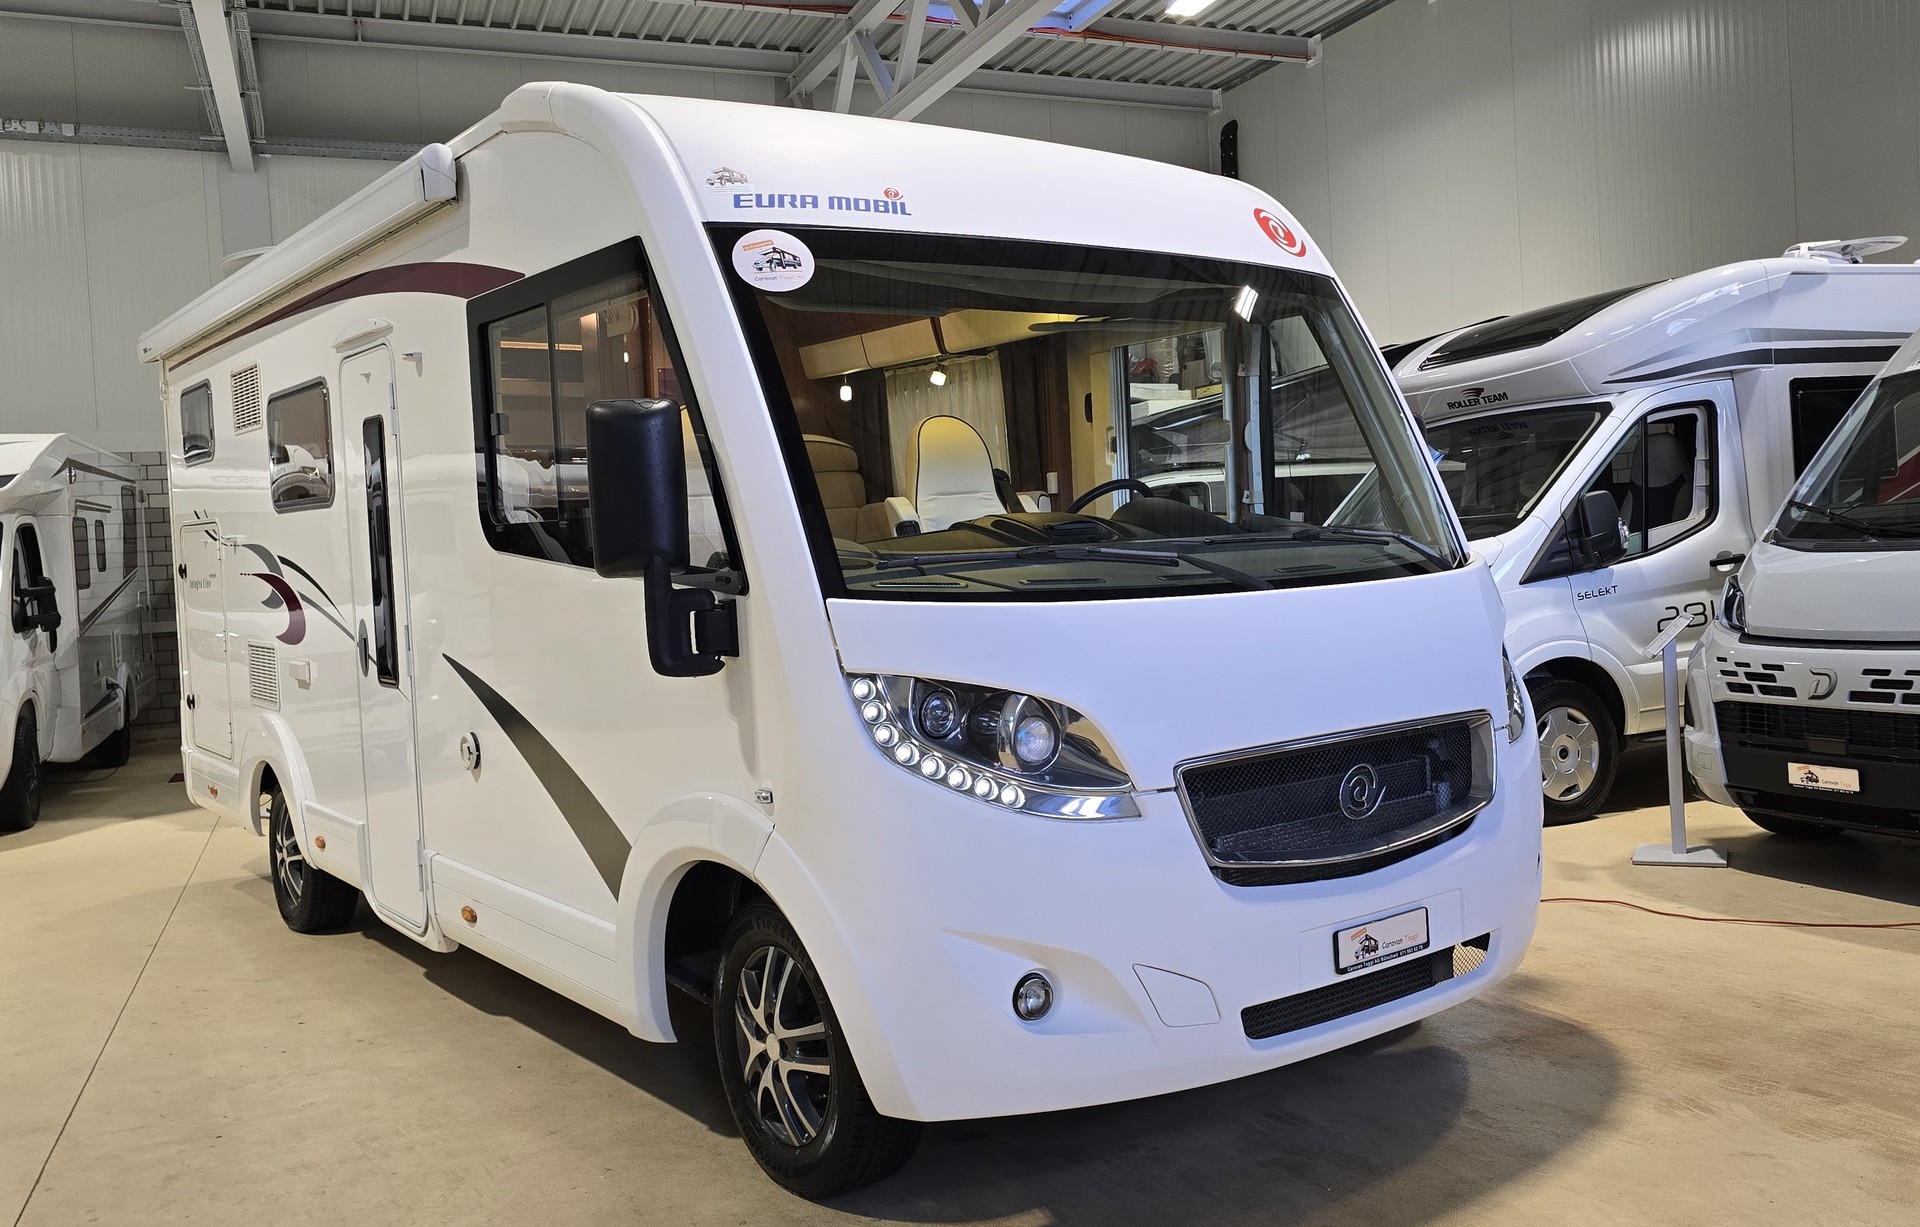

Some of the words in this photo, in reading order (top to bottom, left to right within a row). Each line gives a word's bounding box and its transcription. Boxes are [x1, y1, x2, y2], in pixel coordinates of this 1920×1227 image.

[733, 193, 818, 209] EURA
[828, 195, 911, 215] MOBIL
[1447, 398, 1481, 410] ROLLER
[1481, 391, 1508, 405] TEAM
[1577, 585, 1618, 600] SELEKT
[1381, 938, 1403, 949] Caravan
